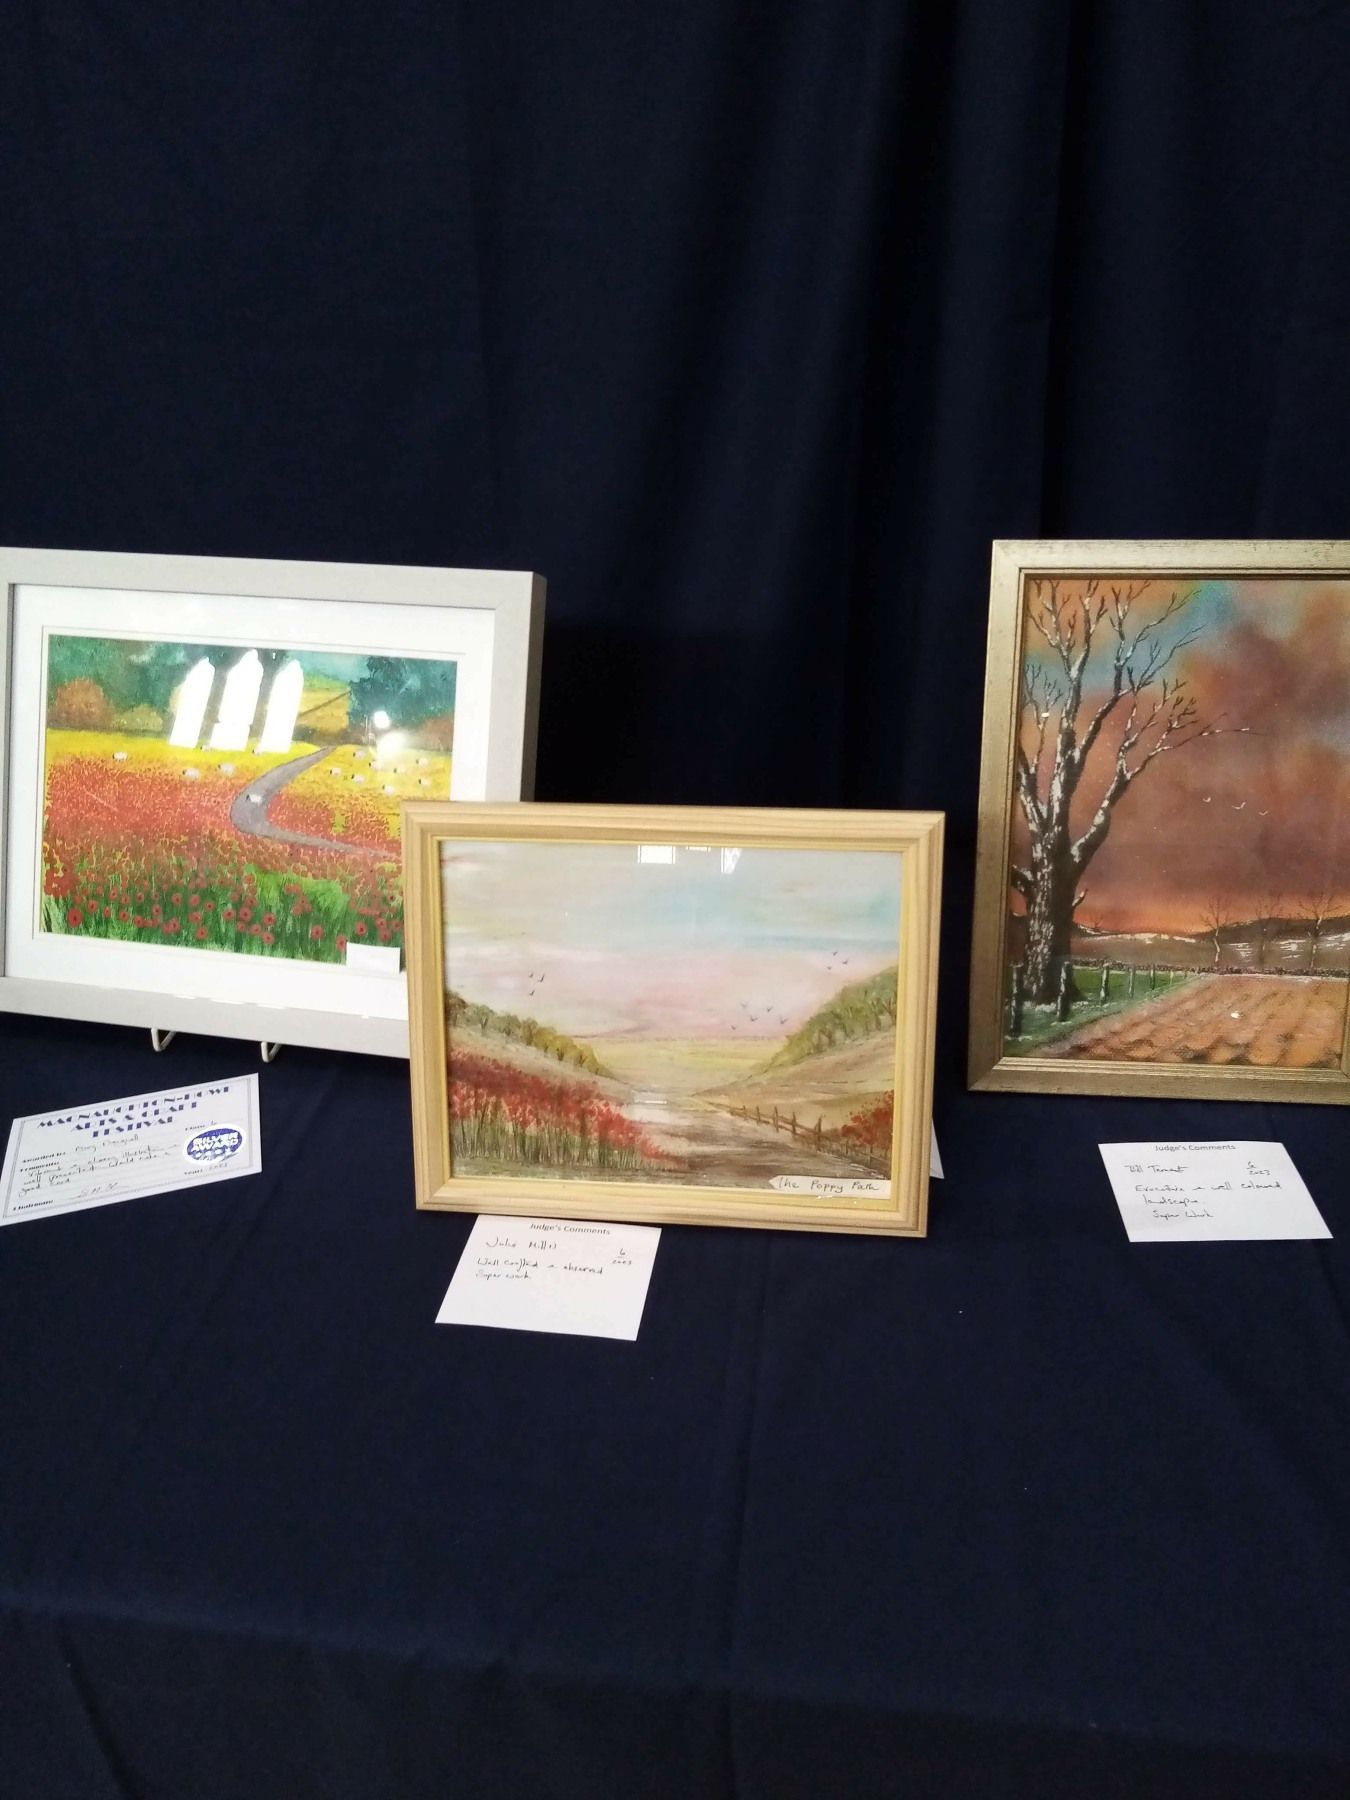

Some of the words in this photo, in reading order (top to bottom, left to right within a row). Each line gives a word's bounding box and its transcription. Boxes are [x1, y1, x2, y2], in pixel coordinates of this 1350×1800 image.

[1155, 1144, 1187, 1152] Judge's
[1188, 1143, 1237, 1152] Comments
[779, 1177, 800, 1189] The
[811, 1179, 844, 1194] Poppy
[851, 1180, 880, 1192] Path
[530, 1222, 562, 1233] Judge's
[563, 1225, 611, 1236] Comments
